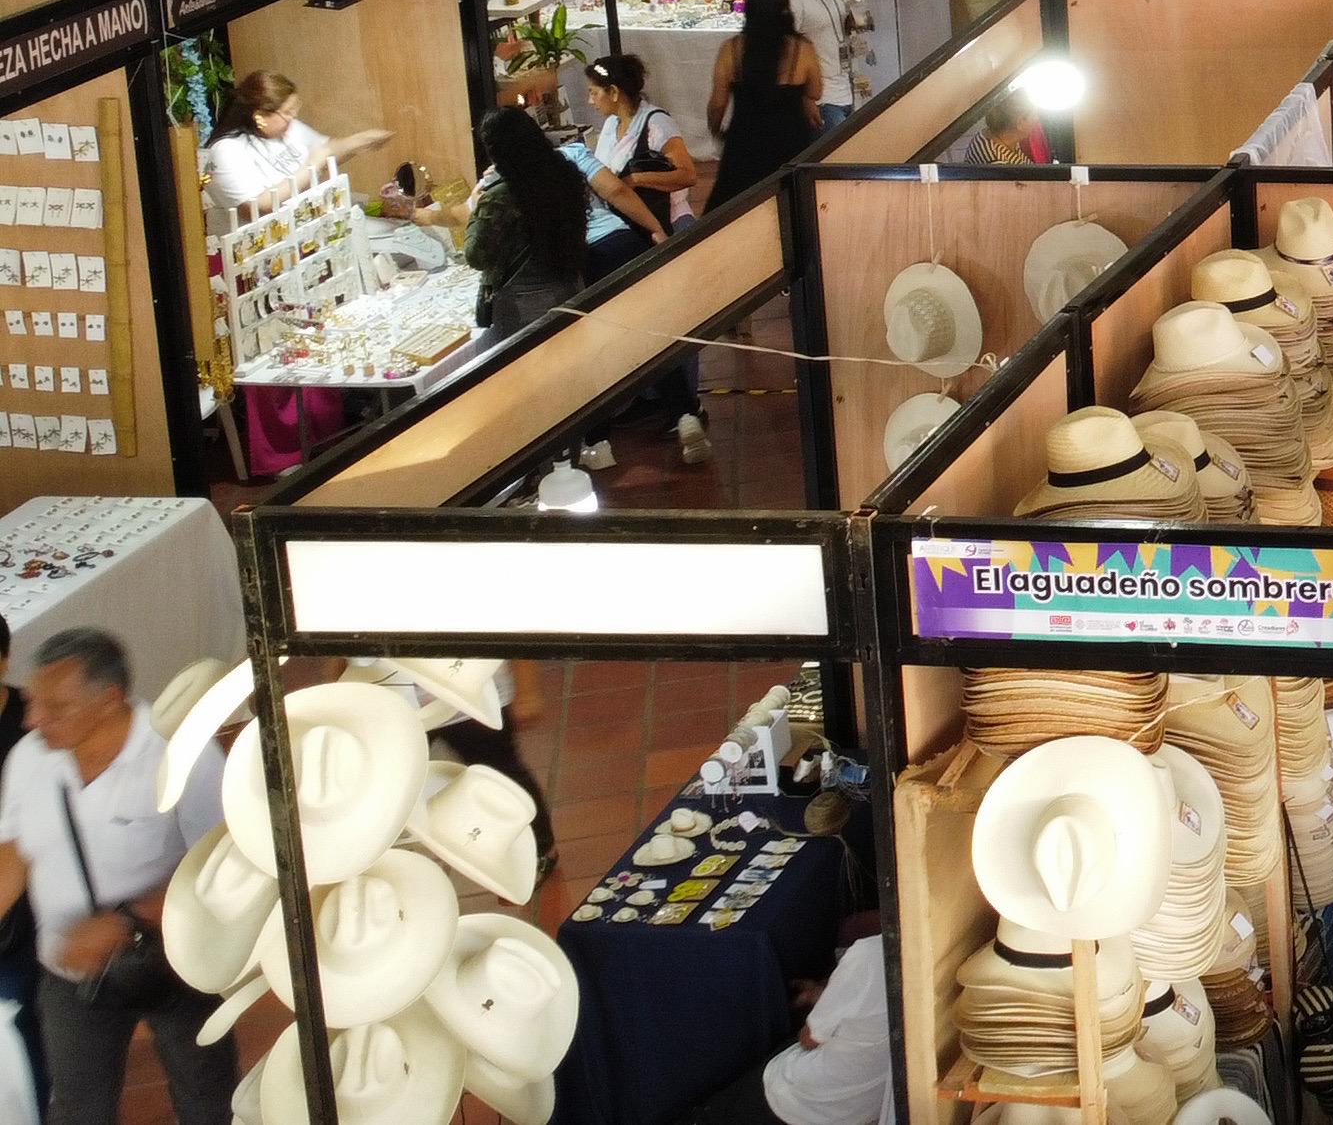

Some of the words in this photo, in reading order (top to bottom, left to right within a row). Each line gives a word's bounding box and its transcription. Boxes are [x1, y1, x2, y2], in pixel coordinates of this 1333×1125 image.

[29, 21, 84, 69] HECHA
[84, 18, 98, 45] A
[974, 567, 1002, 594] El
[1009, 567, 1179, 603] aguadeño
